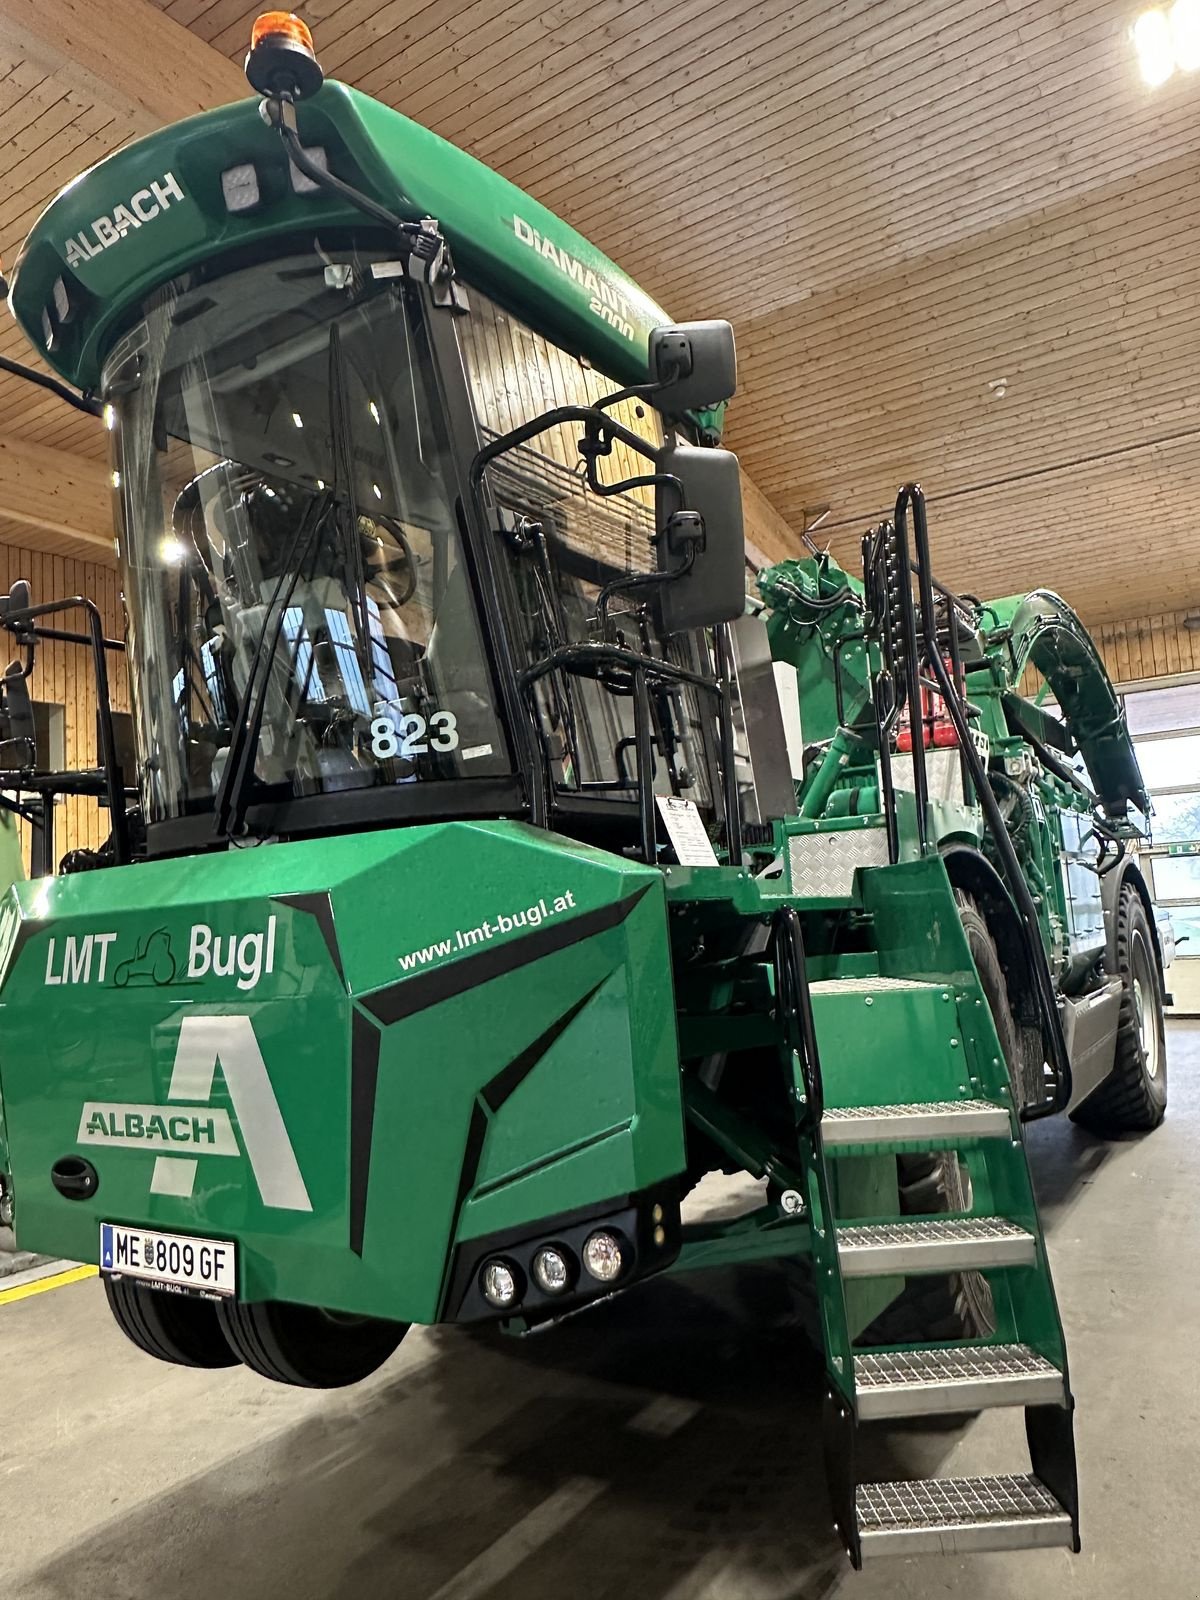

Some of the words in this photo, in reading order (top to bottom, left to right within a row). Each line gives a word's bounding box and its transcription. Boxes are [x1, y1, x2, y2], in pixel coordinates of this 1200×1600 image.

[65, 171, 186, 268] ALBACH
[370, 711, 459, 759] 823
[44, 932, 118, 985] LMT
[187, 915, 277, 990] Bugl
[397, 889, 577, 971] www.lmt-bugl.at
[86, 1111, 216, 1144] ALBACH
[116, 1232, 141, 1267] ME
[156, 1239, 195, 1277] 809
[199, 1246, 226, 1281] GF
